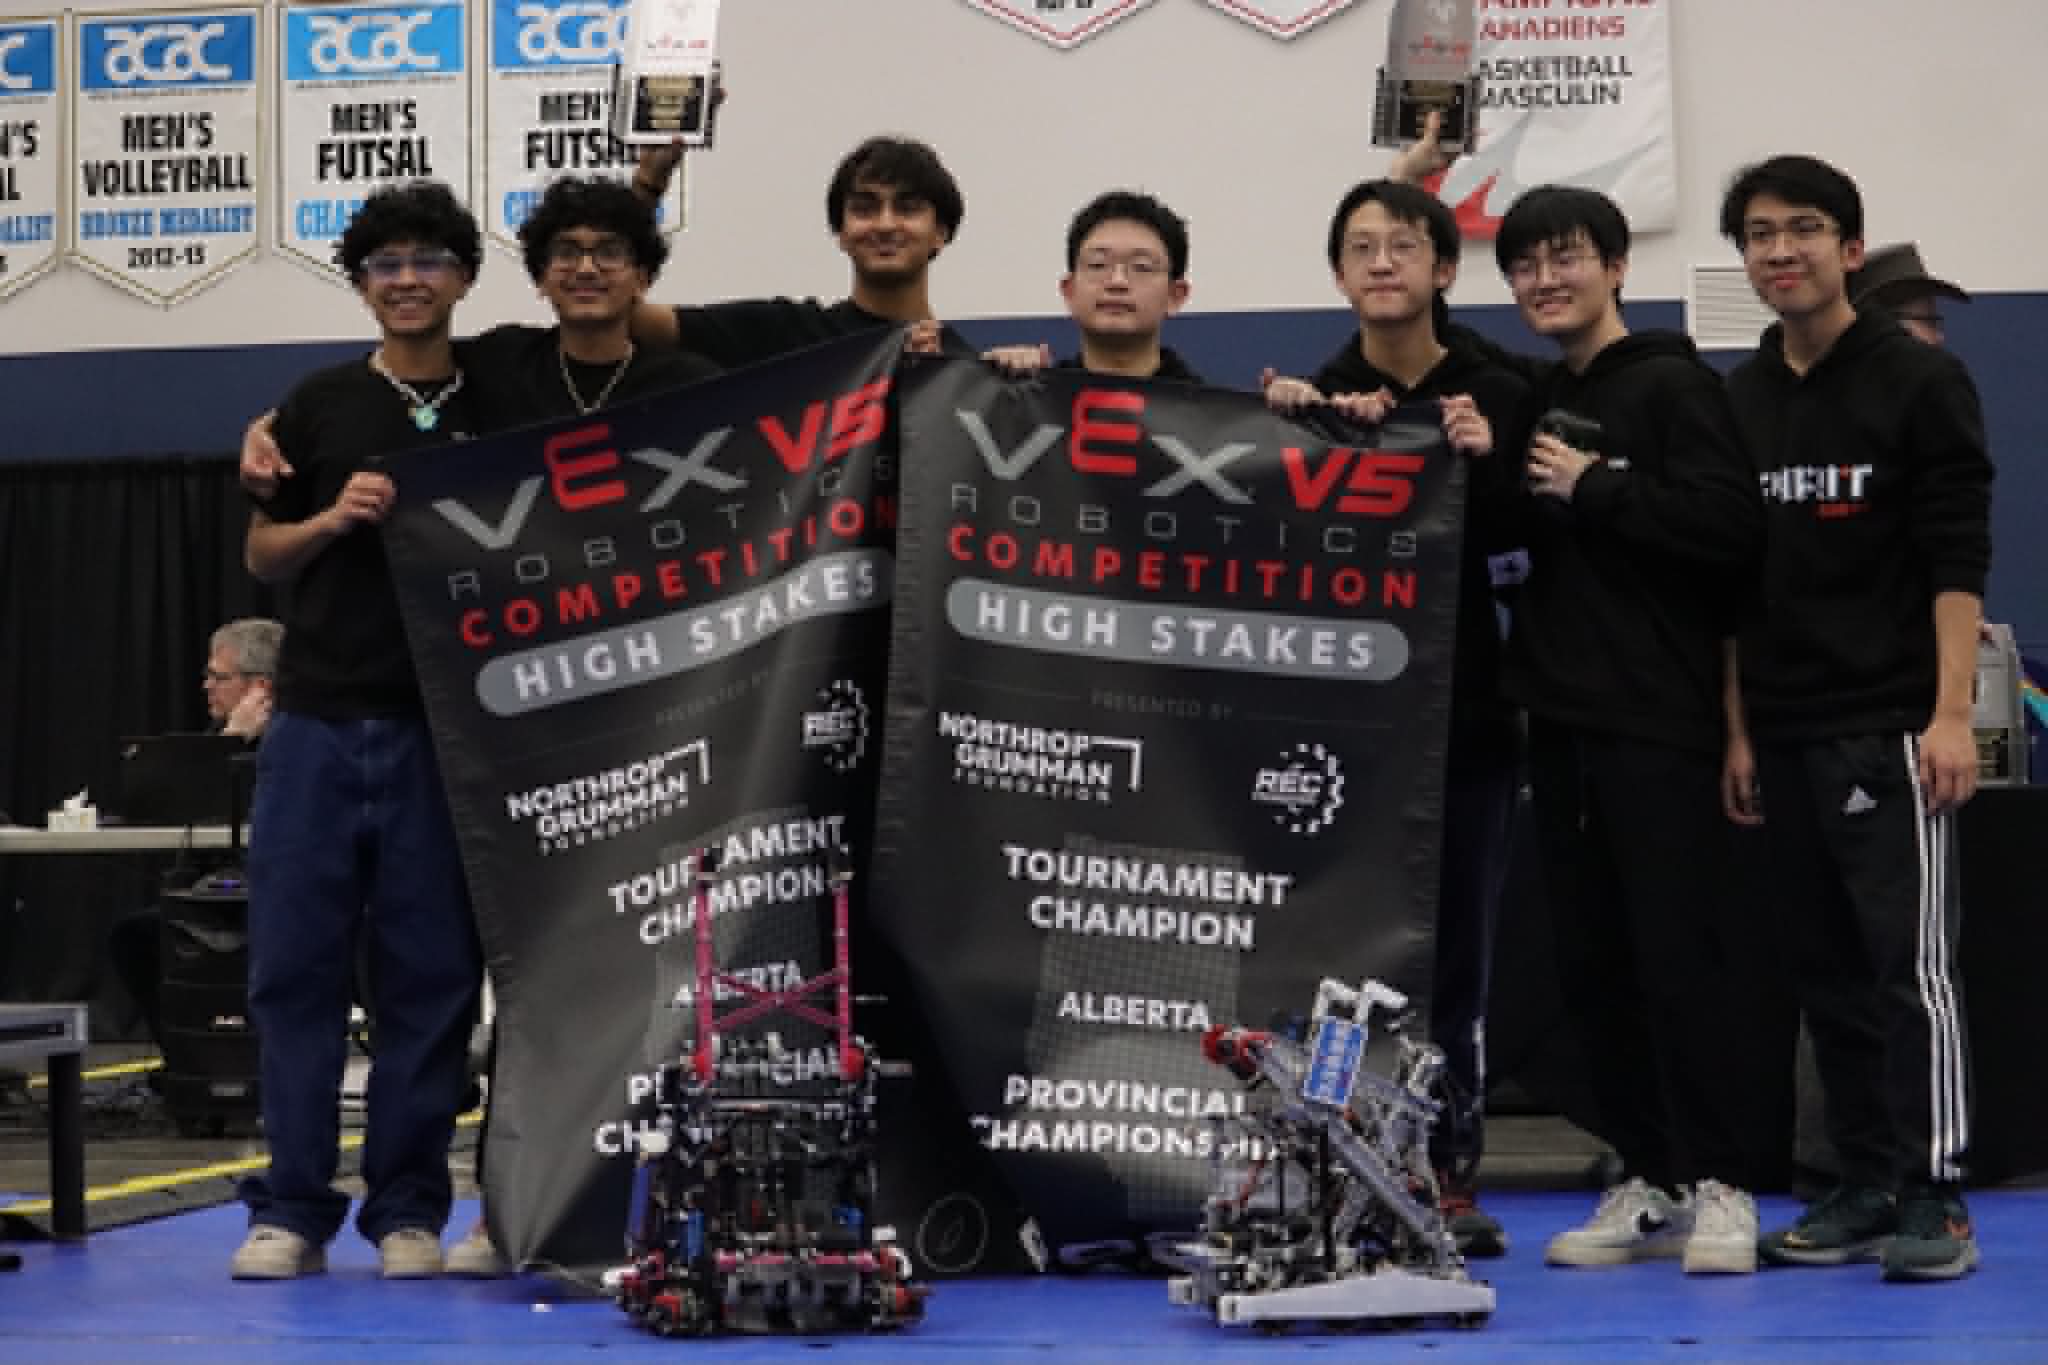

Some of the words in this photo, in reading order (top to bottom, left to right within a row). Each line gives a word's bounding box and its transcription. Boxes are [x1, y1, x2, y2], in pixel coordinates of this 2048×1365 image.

[1480, 16, 1625, 40] ANADIENS
[1480, 55, 1632, 82] ASKETBALL
[120, 112, 214, 152] MEN'S
[331, 102, 417, 134] MEN'S
[82, 153, 252, 198] VOLLEYBALL
[317, 136, 432, 182] FUTSAL
[432, 424, 750, 550] VEX
[758, 375, 893, 474] V5
[956, 390, 1257, 505] VEX
[1281, 447, 1425, 514] V5
[951, 482, 1418, 556] ROBOTICS
[459, 496, 896, 647] COMPETITION
[946, 520, 1417, 608] COMPETITION
[511, 631, 662, 702] HIGH
[688, 560, 875, 656] STAKES
[976, 591, 1120, 645] HIGH
[1151, 614, 1377, 669] STAKES
[938, 711, 1090, 757] NORTHROP
[954, 742, 1113, 786] GRUMMAN
[505, 752, 664, 821] NORTHROP
[536, 771, 689, 840] GRUMMAN
[608, 815, 847, 914] TOUAMENT
[1001, 841, 1295, 906] TOURNAMENT
[1028, 894, 1257, 951] CHAMPION
[1057, 990, 1212, 1032] ALBERTA
